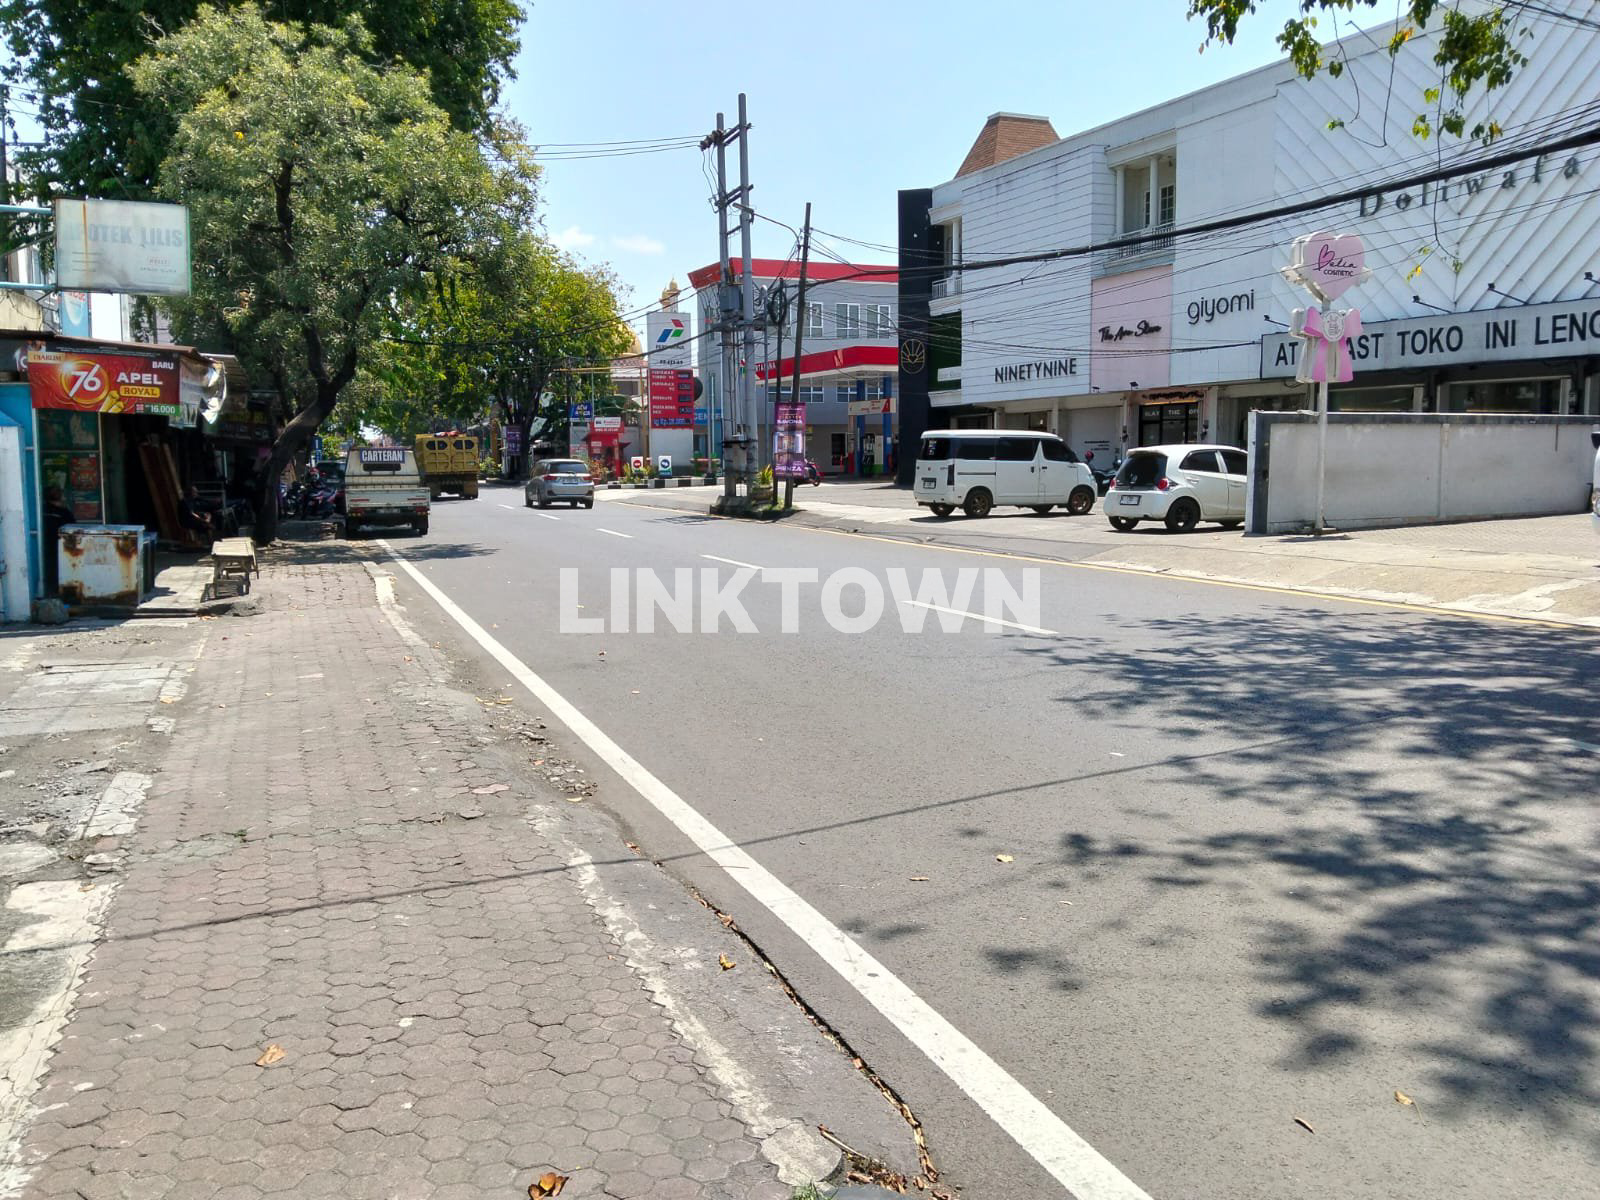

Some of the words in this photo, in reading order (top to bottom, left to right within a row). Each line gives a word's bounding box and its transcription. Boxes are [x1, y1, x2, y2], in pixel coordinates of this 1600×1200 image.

[1359, 154, 1580, 218] Deliwafa
[1323, 268, 1354, 278] COSMETIC
[1187, 288, 1255, 326] giyomi
[1274, 341, 1299, 367] AT
[1346, 332, 1385, 361] AST
[1398, 325, 1464, 357] TOKO
[1485, 319, 1517, 350] INI
[152, 361, 174, 370] BARU
[994, 357, 1077, 384] NINETYNINE
[69, 364, 101, 398] 76
[116, 372, 163, 385] APEL
[122, 386, 158, 397] ROYAL
[361, 449, 404, 463] CARTERAN
